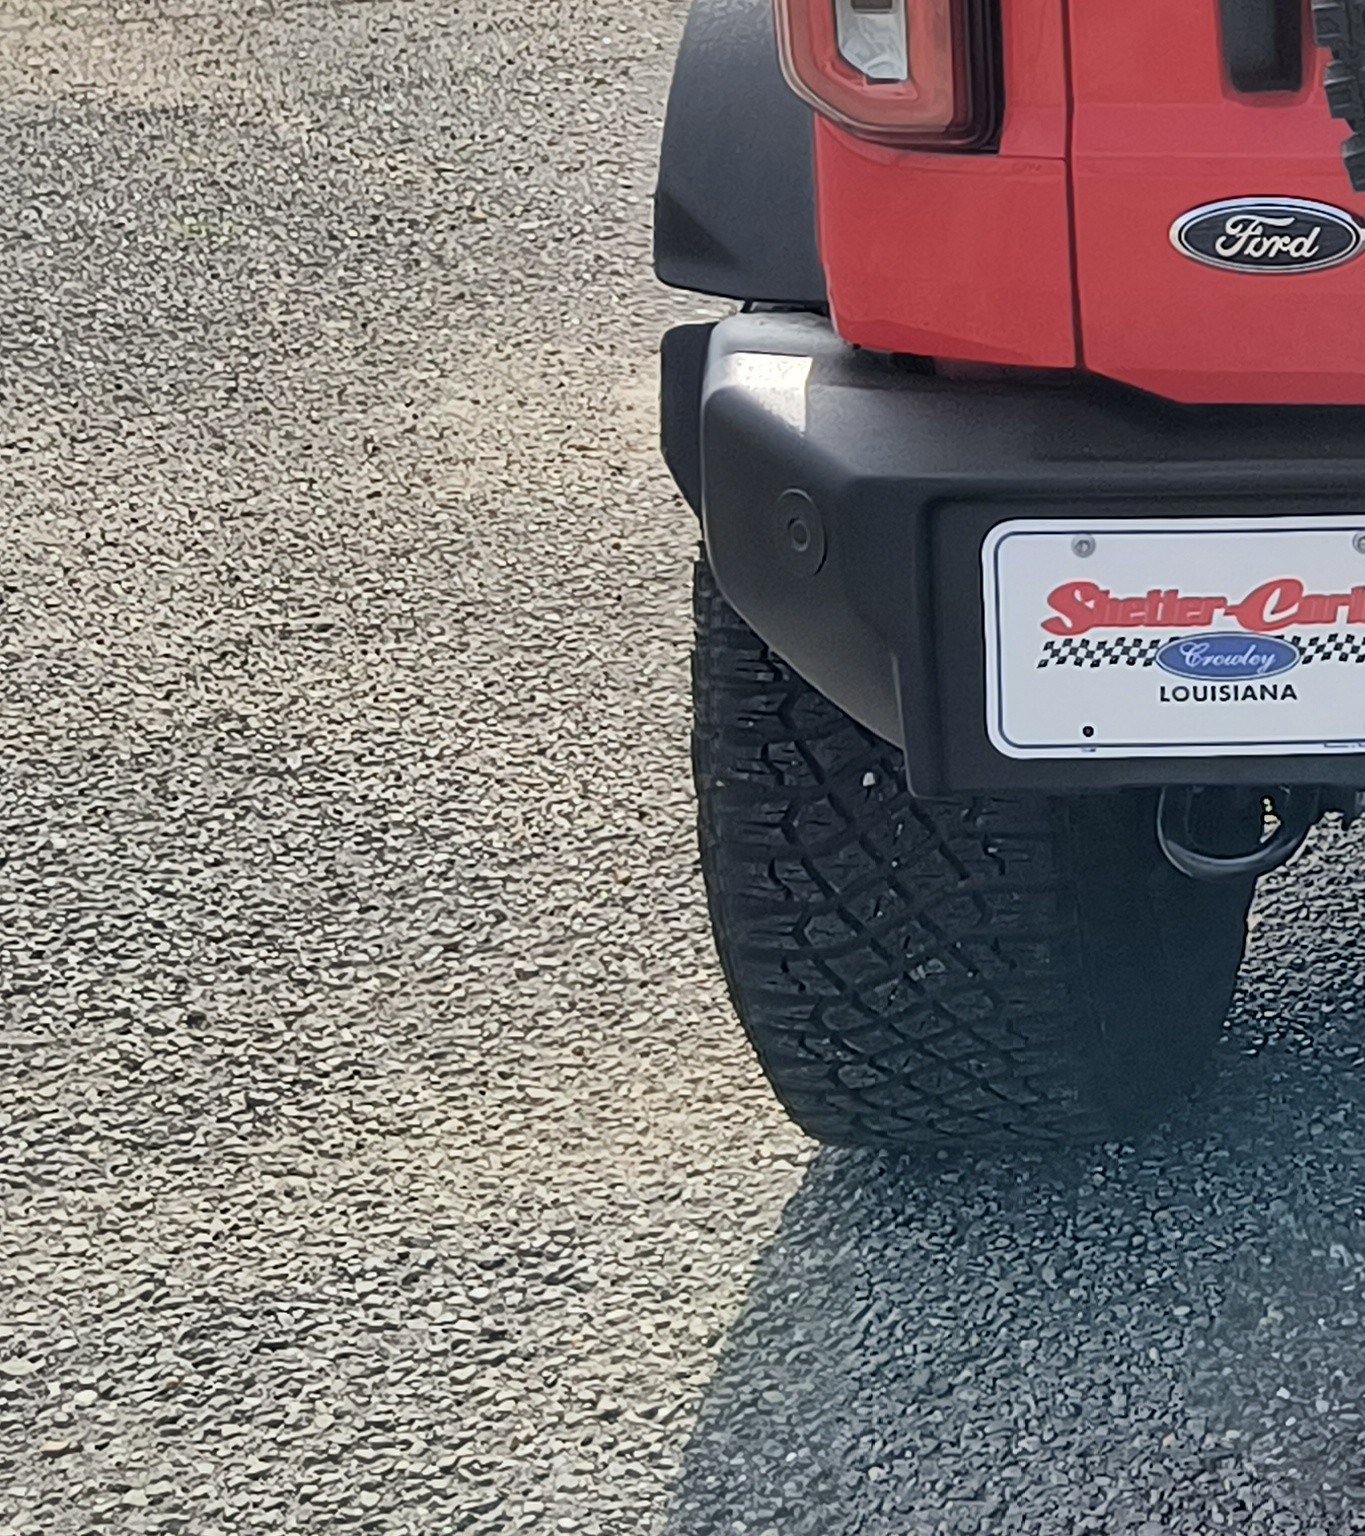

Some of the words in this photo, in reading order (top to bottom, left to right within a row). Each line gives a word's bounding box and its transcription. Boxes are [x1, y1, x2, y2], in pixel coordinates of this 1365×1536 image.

[1215, 214, 1322, 259] Ford
[1179, 642, 1277, 674] Crowley
[1159, 684, 1298, 703] LOUISIANA
